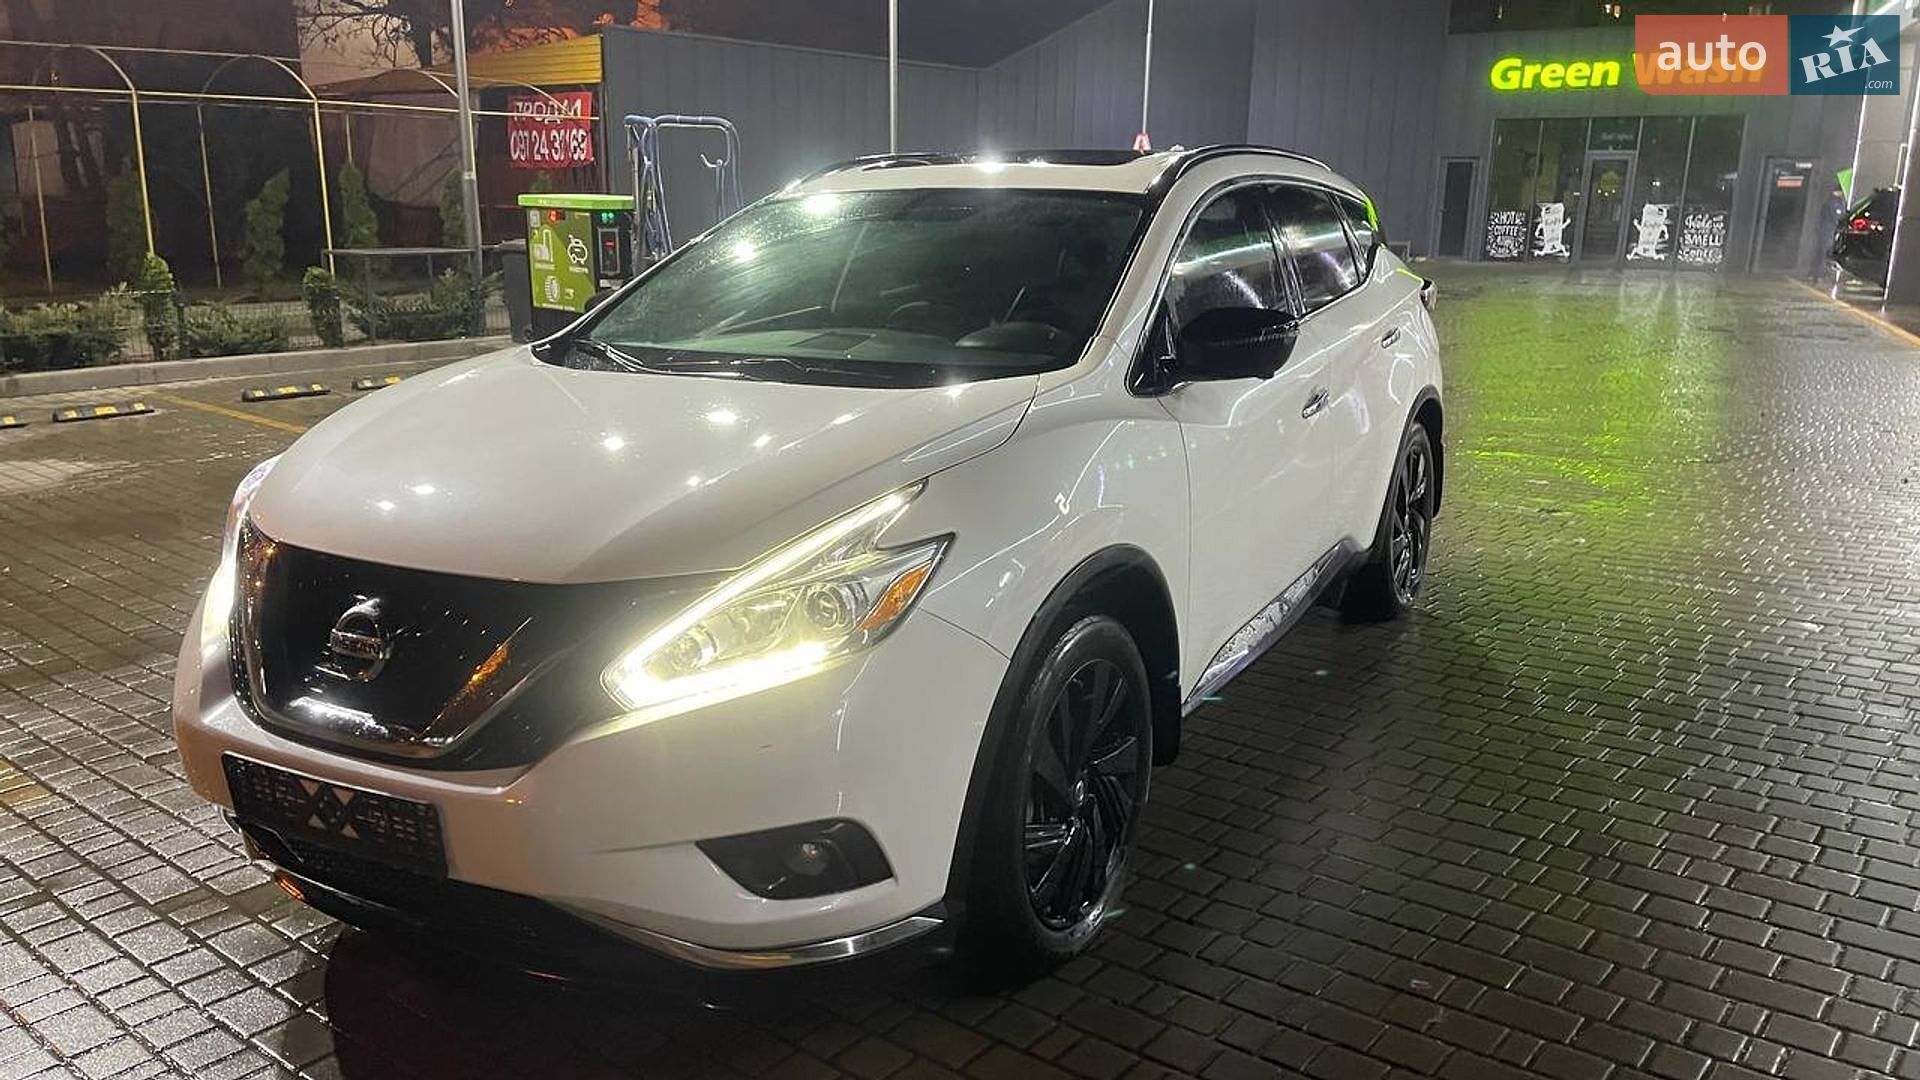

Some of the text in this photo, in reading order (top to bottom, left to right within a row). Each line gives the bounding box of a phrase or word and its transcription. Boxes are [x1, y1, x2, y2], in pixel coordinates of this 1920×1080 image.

[1490, 57, 1620, 90] Green
[531, 129, 549, 161] 24
[1684, 234, 1721, 246] SMELL
